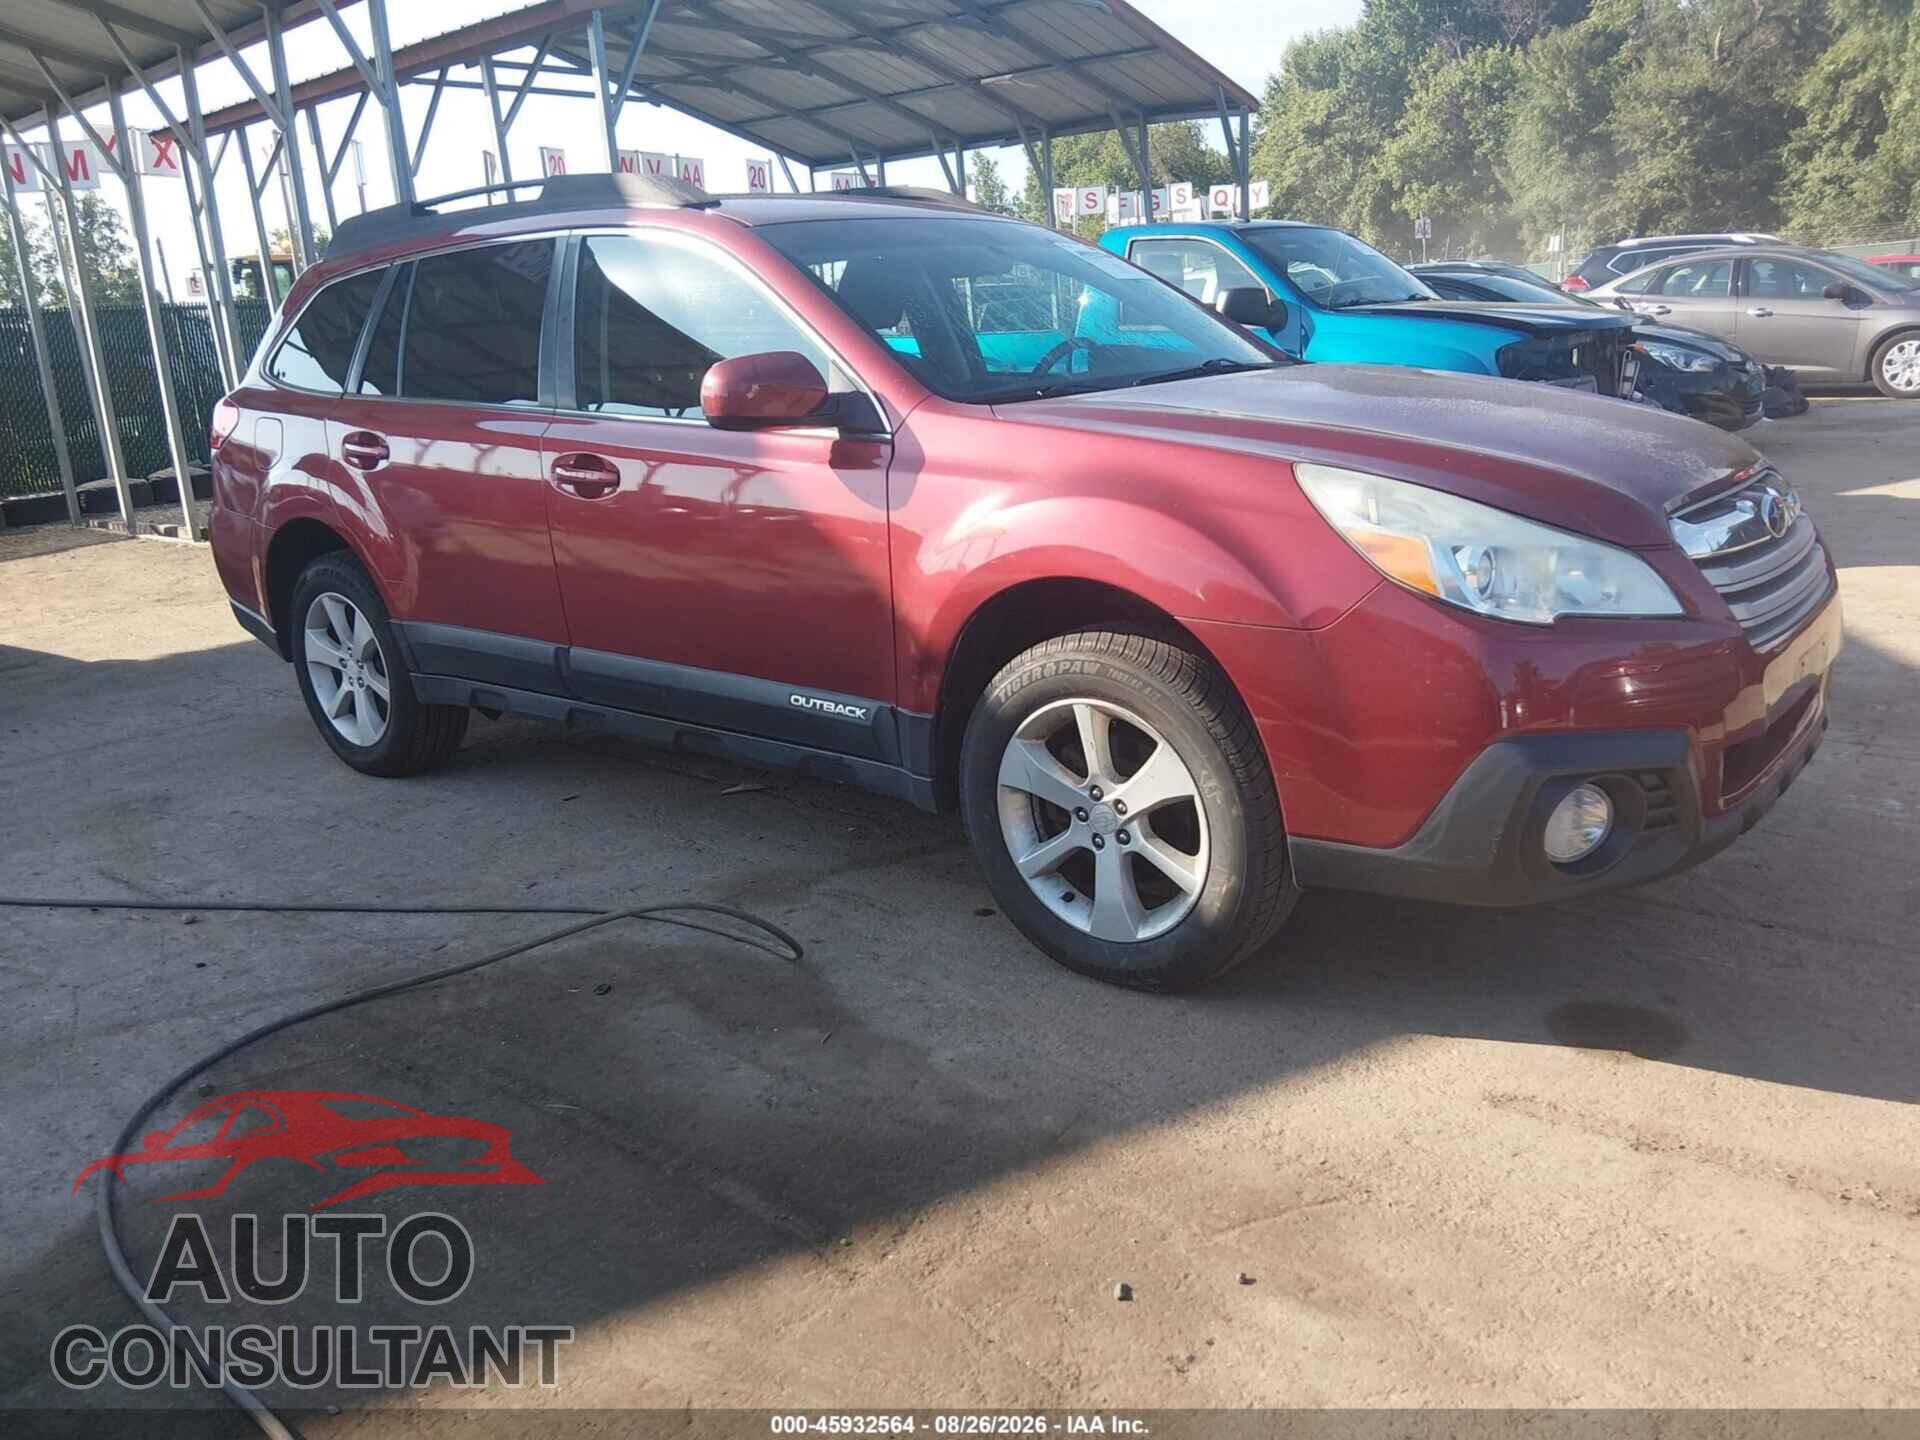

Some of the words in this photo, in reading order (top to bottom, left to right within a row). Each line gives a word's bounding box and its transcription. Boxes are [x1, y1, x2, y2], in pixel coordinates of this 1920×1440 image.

[152, 135, 177, 169] X
[750, 166, 766, 188] 20
[1085, 192, 1098, 209] S
[1175, 188, 1187, 204] S
[1214, 190, 1229, 207] Q
[1057, 659, 1101, 675] PAW
[790, 694, 867, 720] OUTBACK
